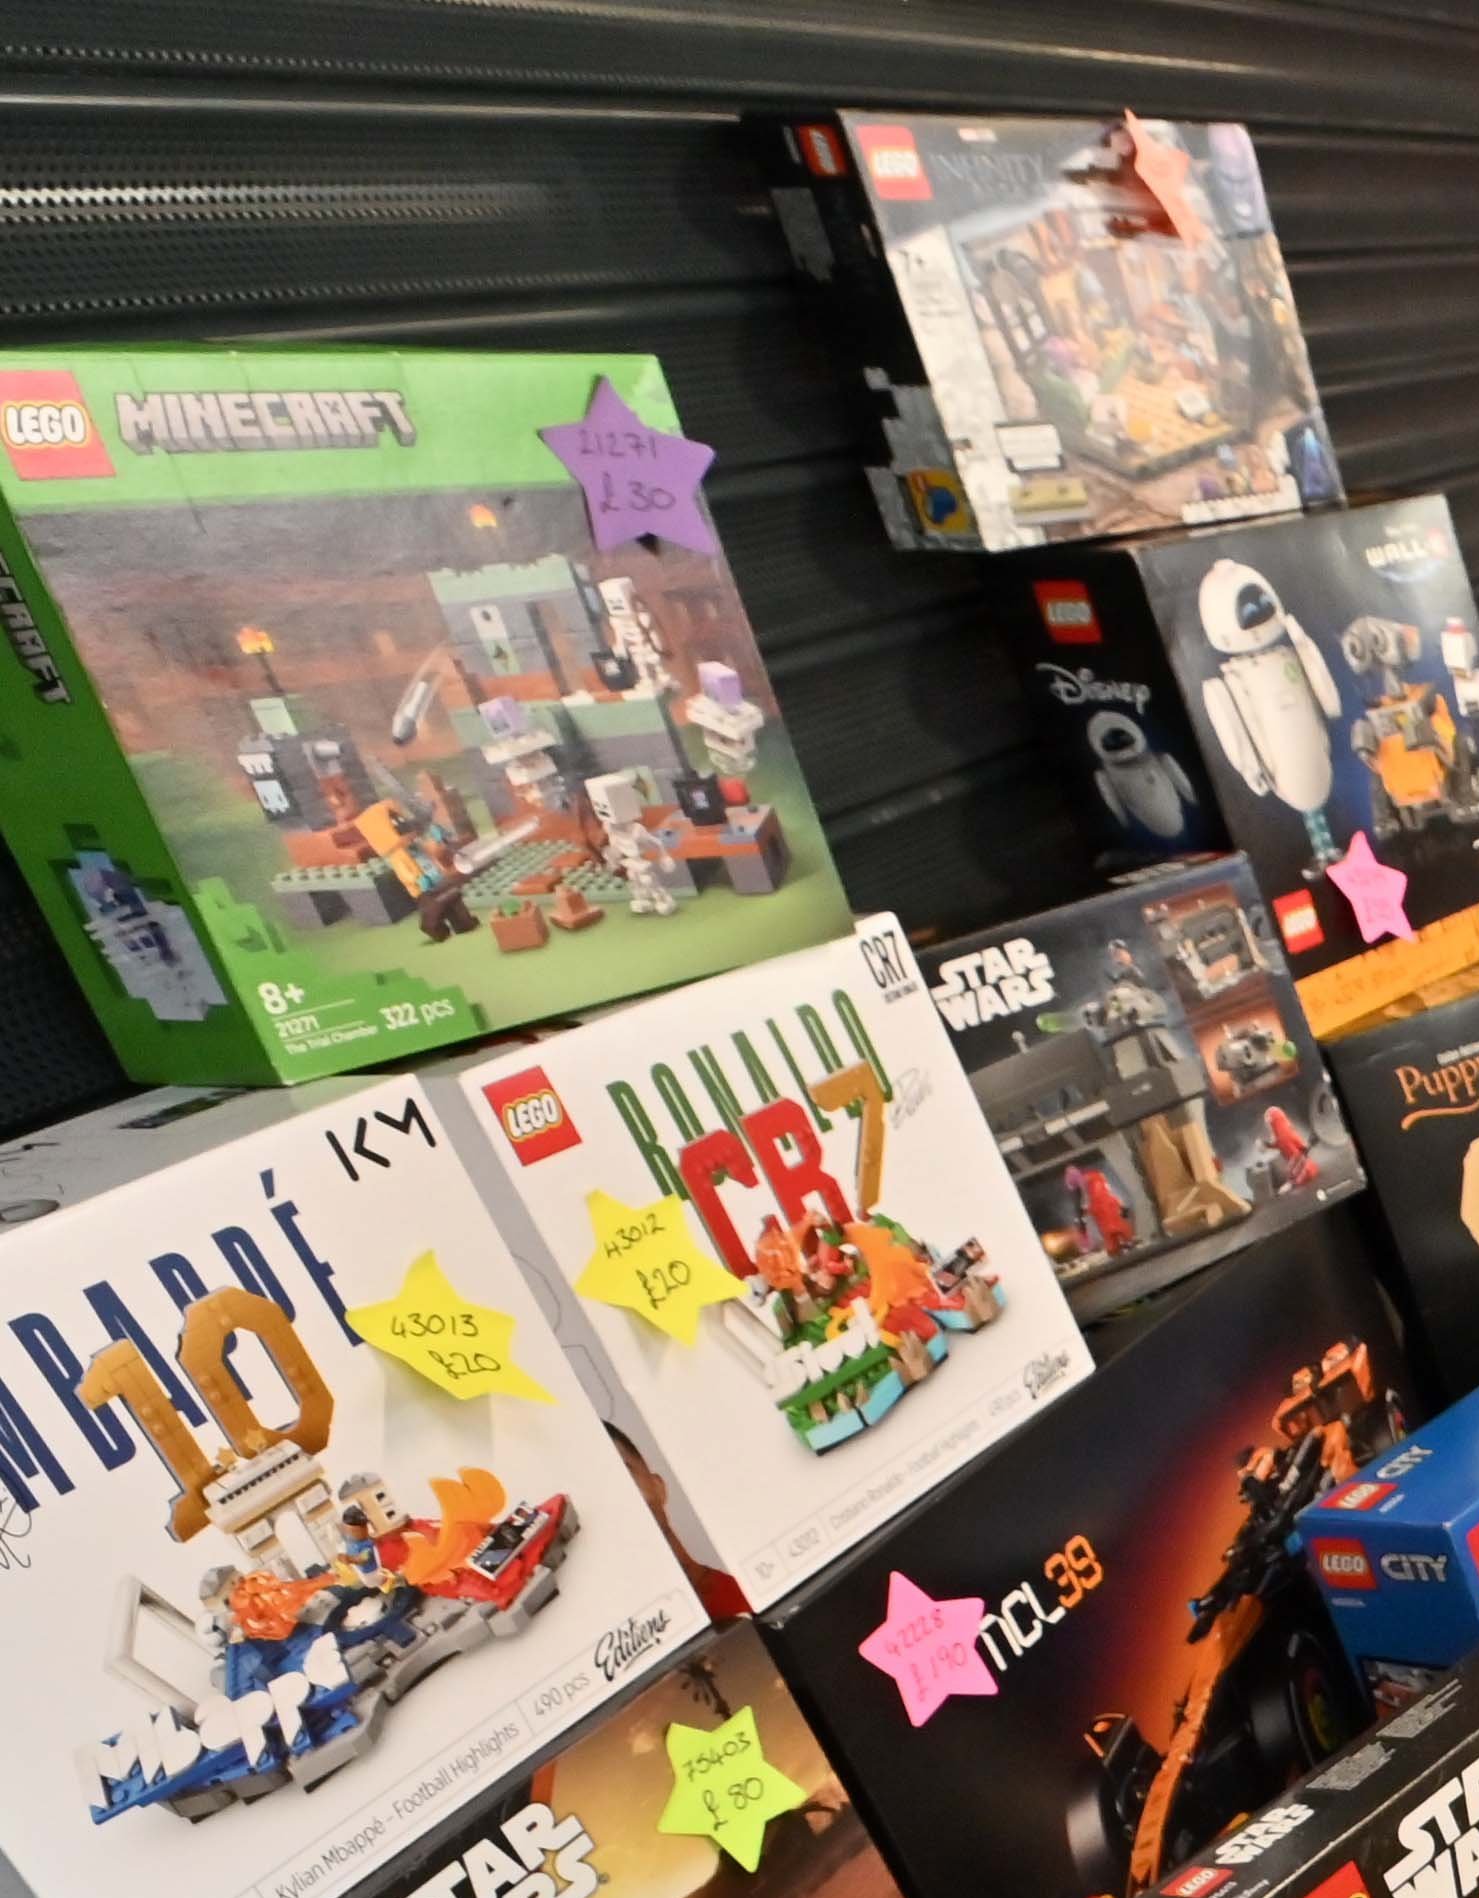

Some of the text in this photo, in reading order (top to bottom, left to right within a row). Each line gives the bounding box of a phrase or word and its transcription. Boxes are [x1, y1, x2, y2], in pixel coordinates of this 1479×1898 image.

[5, 390, 416, 455] LEGO MINECRAFT
[860, 930, 908, 988] CR7
[930, 938, 1050, 998] STAR
[257, 982, 305, 1014] 8+
[379, 1002, 420, 1030] 322
[420, 999, 456, 1026] pcs
[935, 966, 1055, 1031] WARS
[507, 1093, 559, 1138] LEGO
[605, 1212, 667, 1259] 43012
[636, 1259, 691, 1310] £20
[391, 1312, 480, 1339] 43013
[427, 1349, 501, 1379] £20
[593, 1604, 671, 1683] Editions
[322, 1816, 386, 1878] Mbappé
[392, 1777, 453, 1822] Football
[450, 1721, 521, 1786] Highlights
[533, 1685, 563, 1719] 490
[562, 1671, 591, 1704] pcs
[682, 1731, 753, 1781] 75403
[702, 1776, 765, 1832] £80
